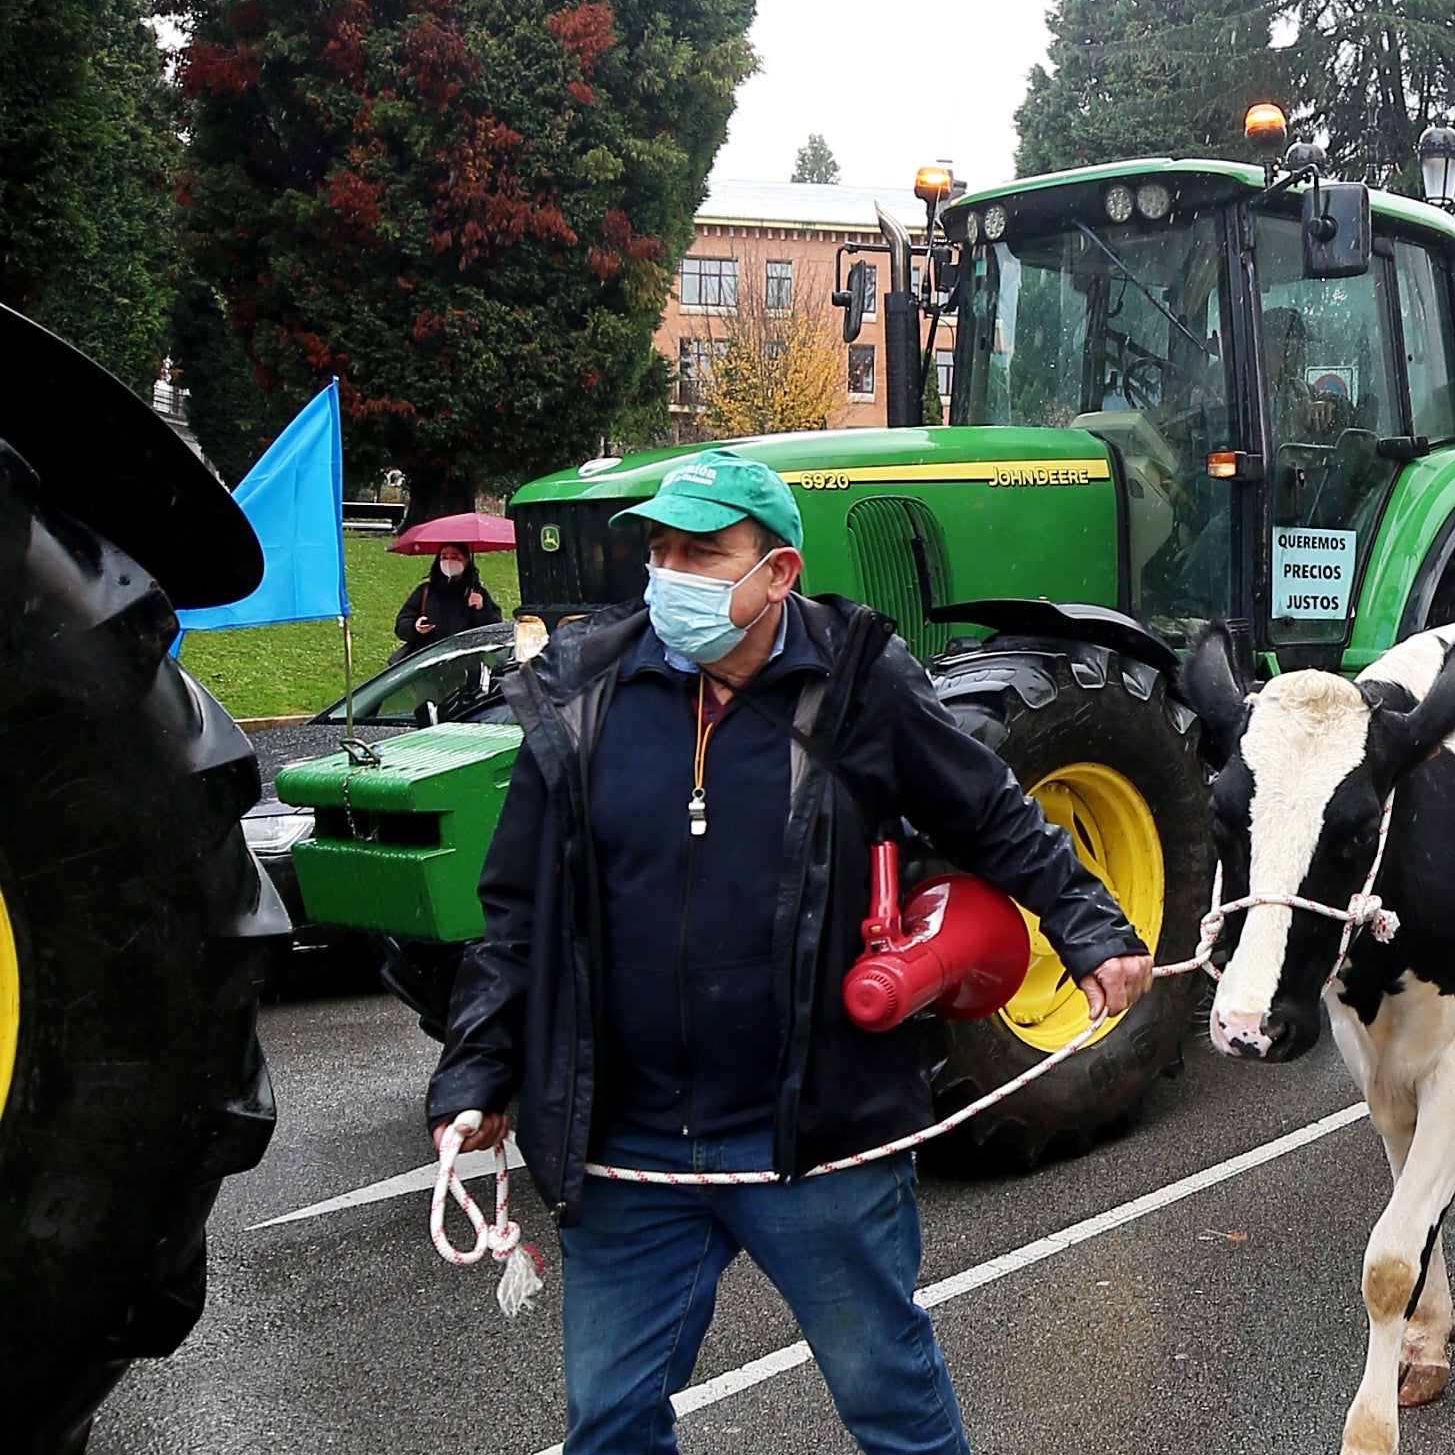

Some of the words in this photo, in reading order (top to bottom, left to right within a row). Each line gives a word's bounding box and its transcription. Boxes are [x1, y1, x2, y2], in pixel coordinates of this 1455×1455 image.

[800, 473, 850, 489] 6920
[988, 467, 1034, 487] JOHN
[1035, 467, 1090, 486] DEERE
[1278, 534, 1346, 551] QUEREMOS
[1284, 563, 1342, 580] PRECIOS
[1286, 595, 1339, 610] JUSTOS
